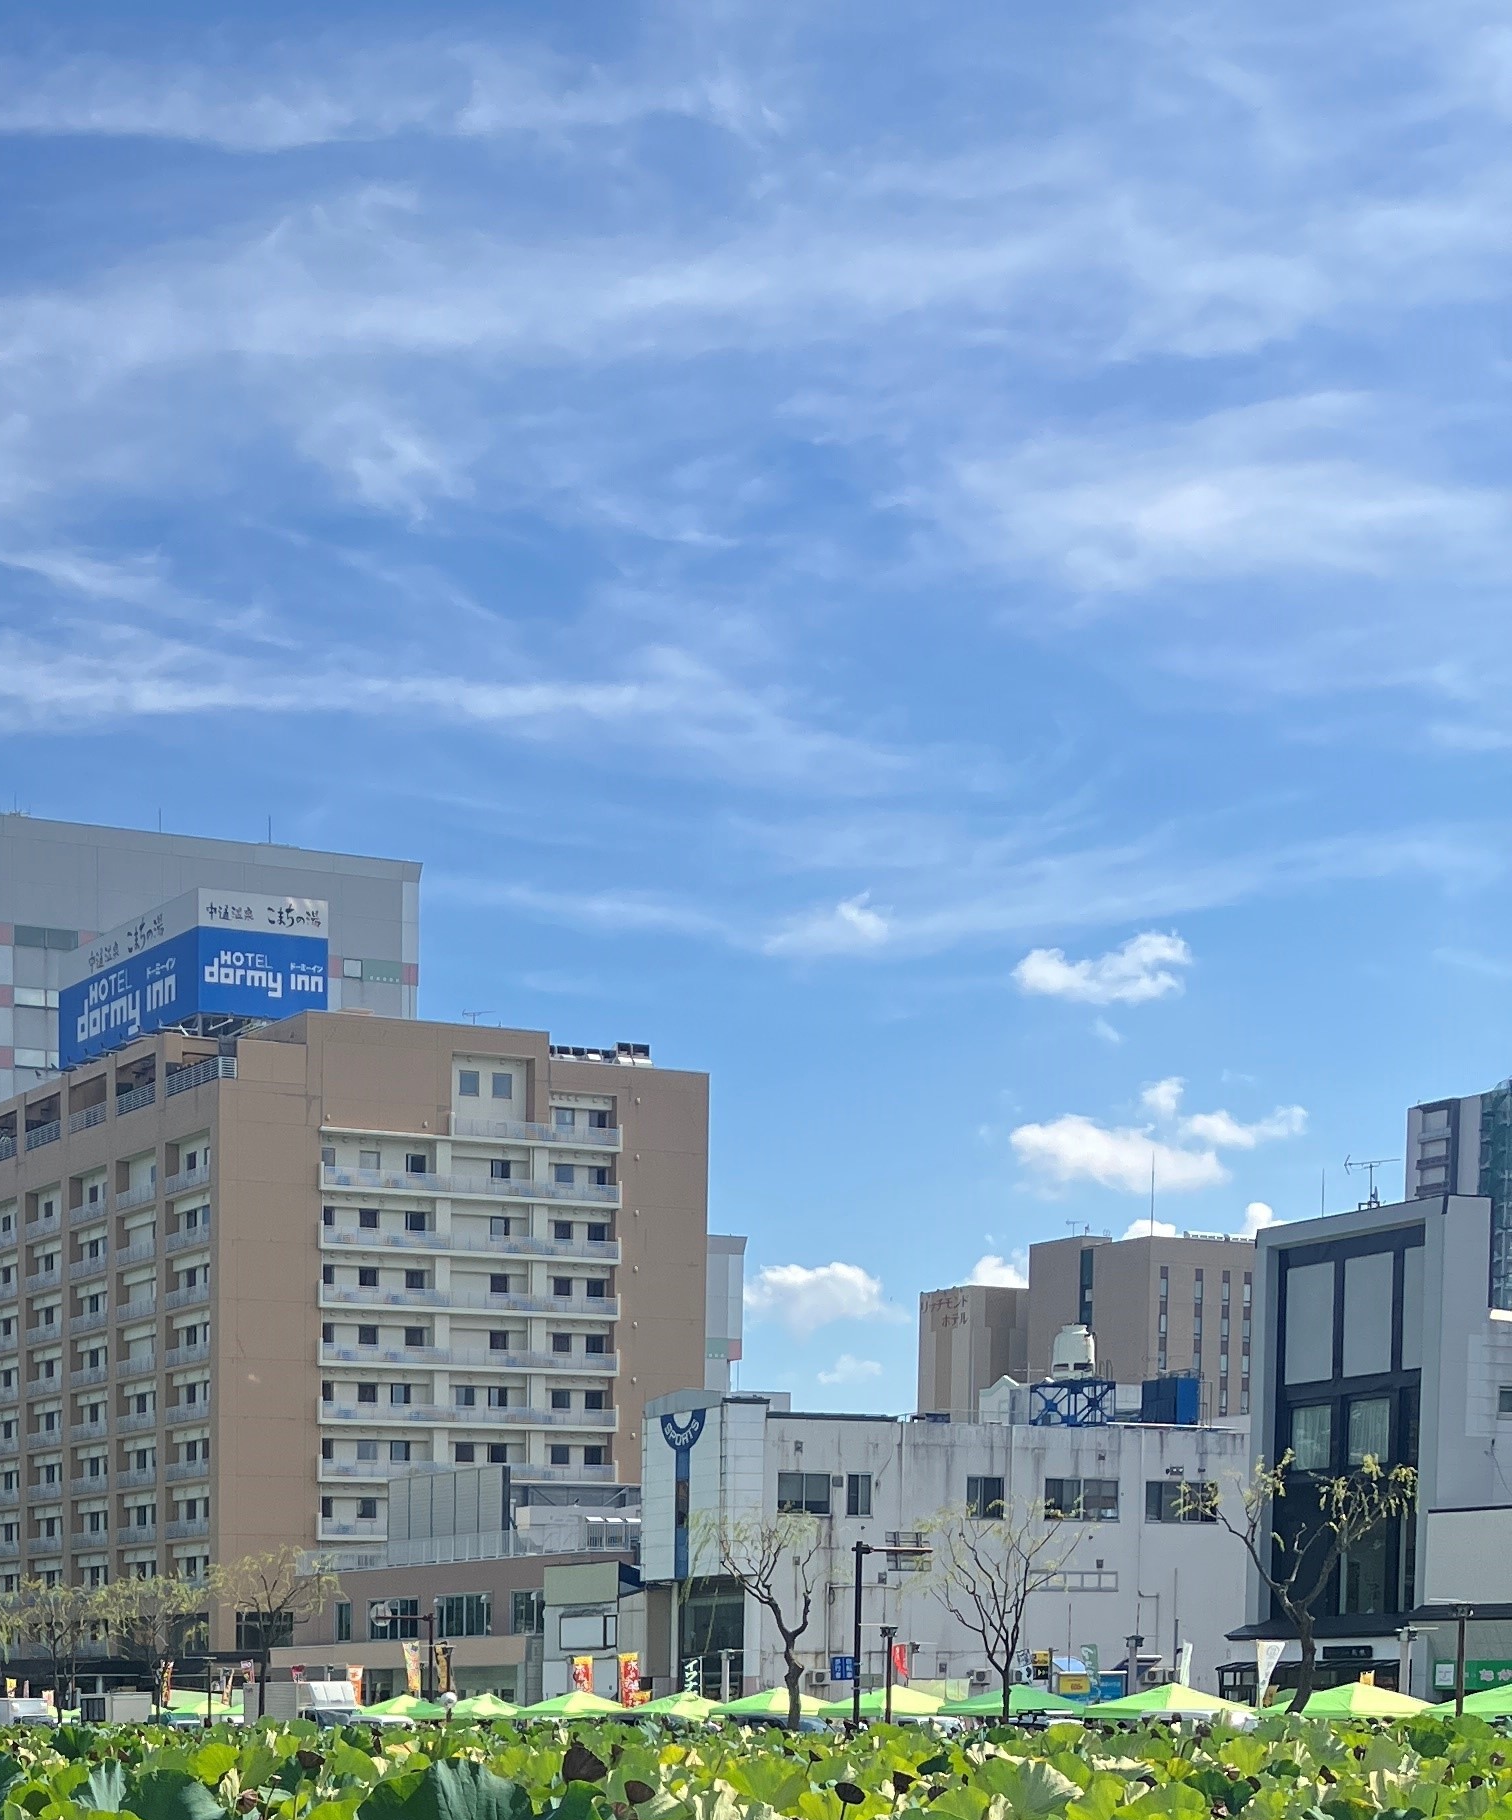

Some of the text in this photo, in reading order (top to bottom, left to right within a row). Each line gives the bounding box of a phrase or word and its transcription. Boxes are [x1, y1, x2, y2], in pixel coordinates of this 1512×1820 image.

[267, 903, 322, 928] こまちの湯
[127, 912, 166, 954] こまちの湯
[146, 957, 176, 980] ドーミーイン
[220, 950, 273, 969] HOTEL
[290, 962, 324, 973] ドーミーイン
[89, 968, 133, 1006] HOTEL
[204, 957, 324, 998] dormy inn
[77, 974, 176, 1043] dormy inn
[664, 1419, 700, 1446] SPORTS
